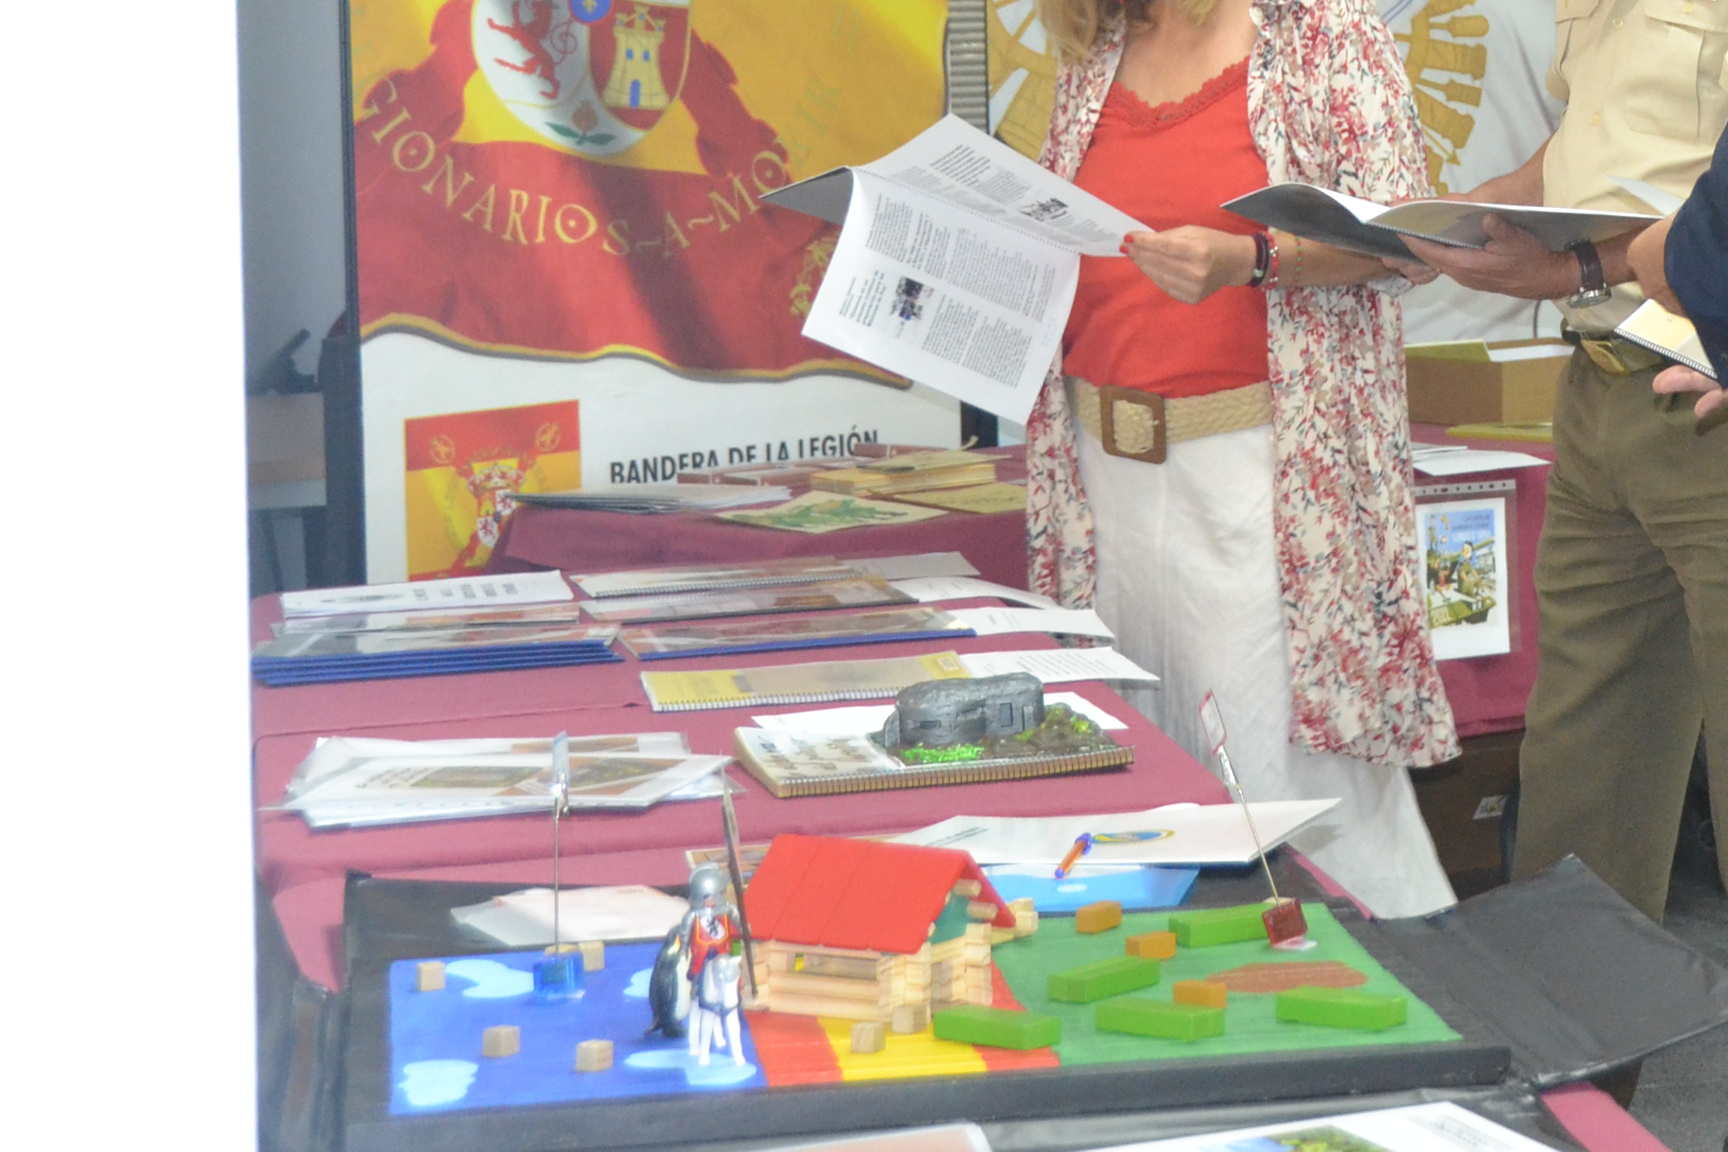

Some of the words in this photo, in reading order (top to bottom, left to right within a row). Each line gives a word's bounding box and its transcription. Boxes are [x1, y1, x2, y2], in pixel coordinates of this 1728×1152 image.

[610, 449, 719, 483] BANDERA
[728, 445, 757, 465] DE
[798, 425, 879, 459] LEGIÓN
